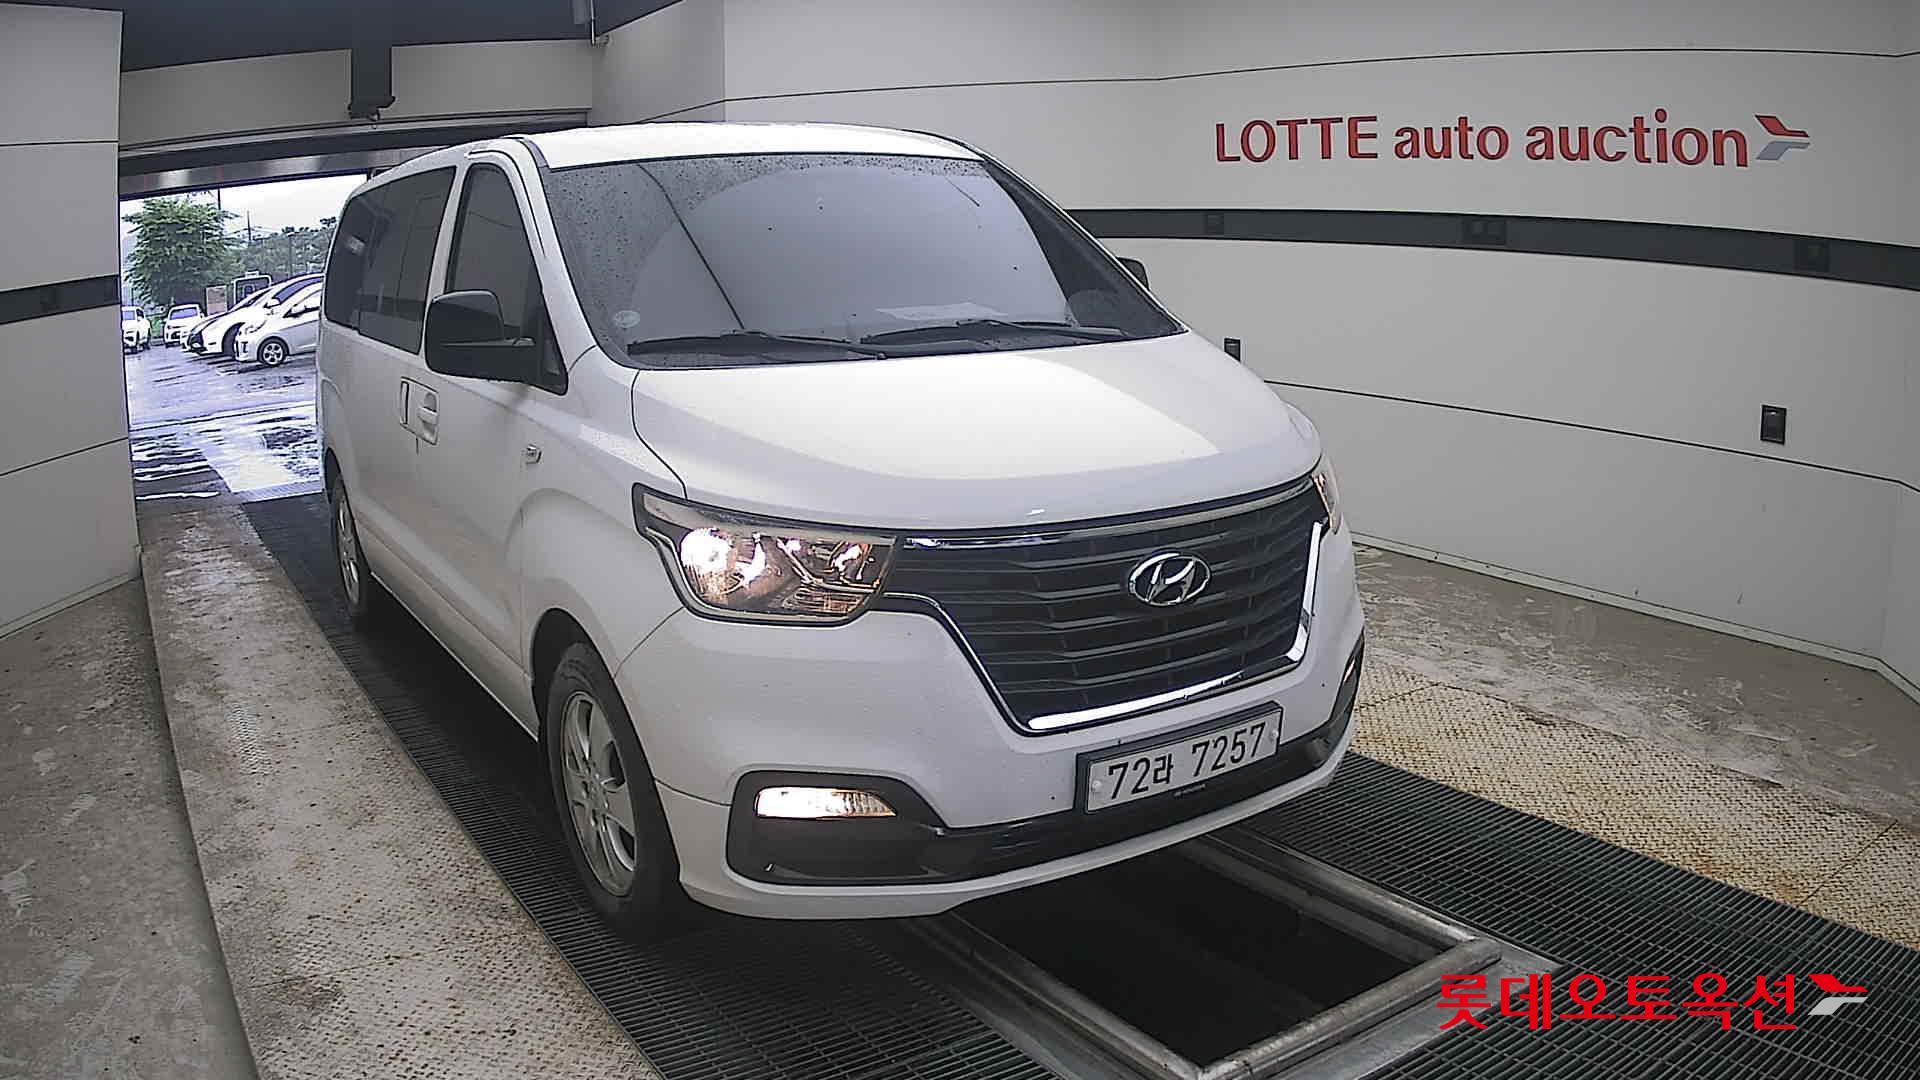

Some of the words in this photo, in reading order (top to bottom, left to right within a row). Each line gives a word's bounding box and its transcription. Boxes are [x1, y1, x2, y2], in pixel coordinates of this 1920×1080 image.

[1216, 116, 1378, 162] LOTTE
[1394, 117, 1509, 161] auto
[1525, 108, 1748, 168] auction
[1107, 752, 1174, 799] 72라
[1191, 722, 1266, 777] 7257
